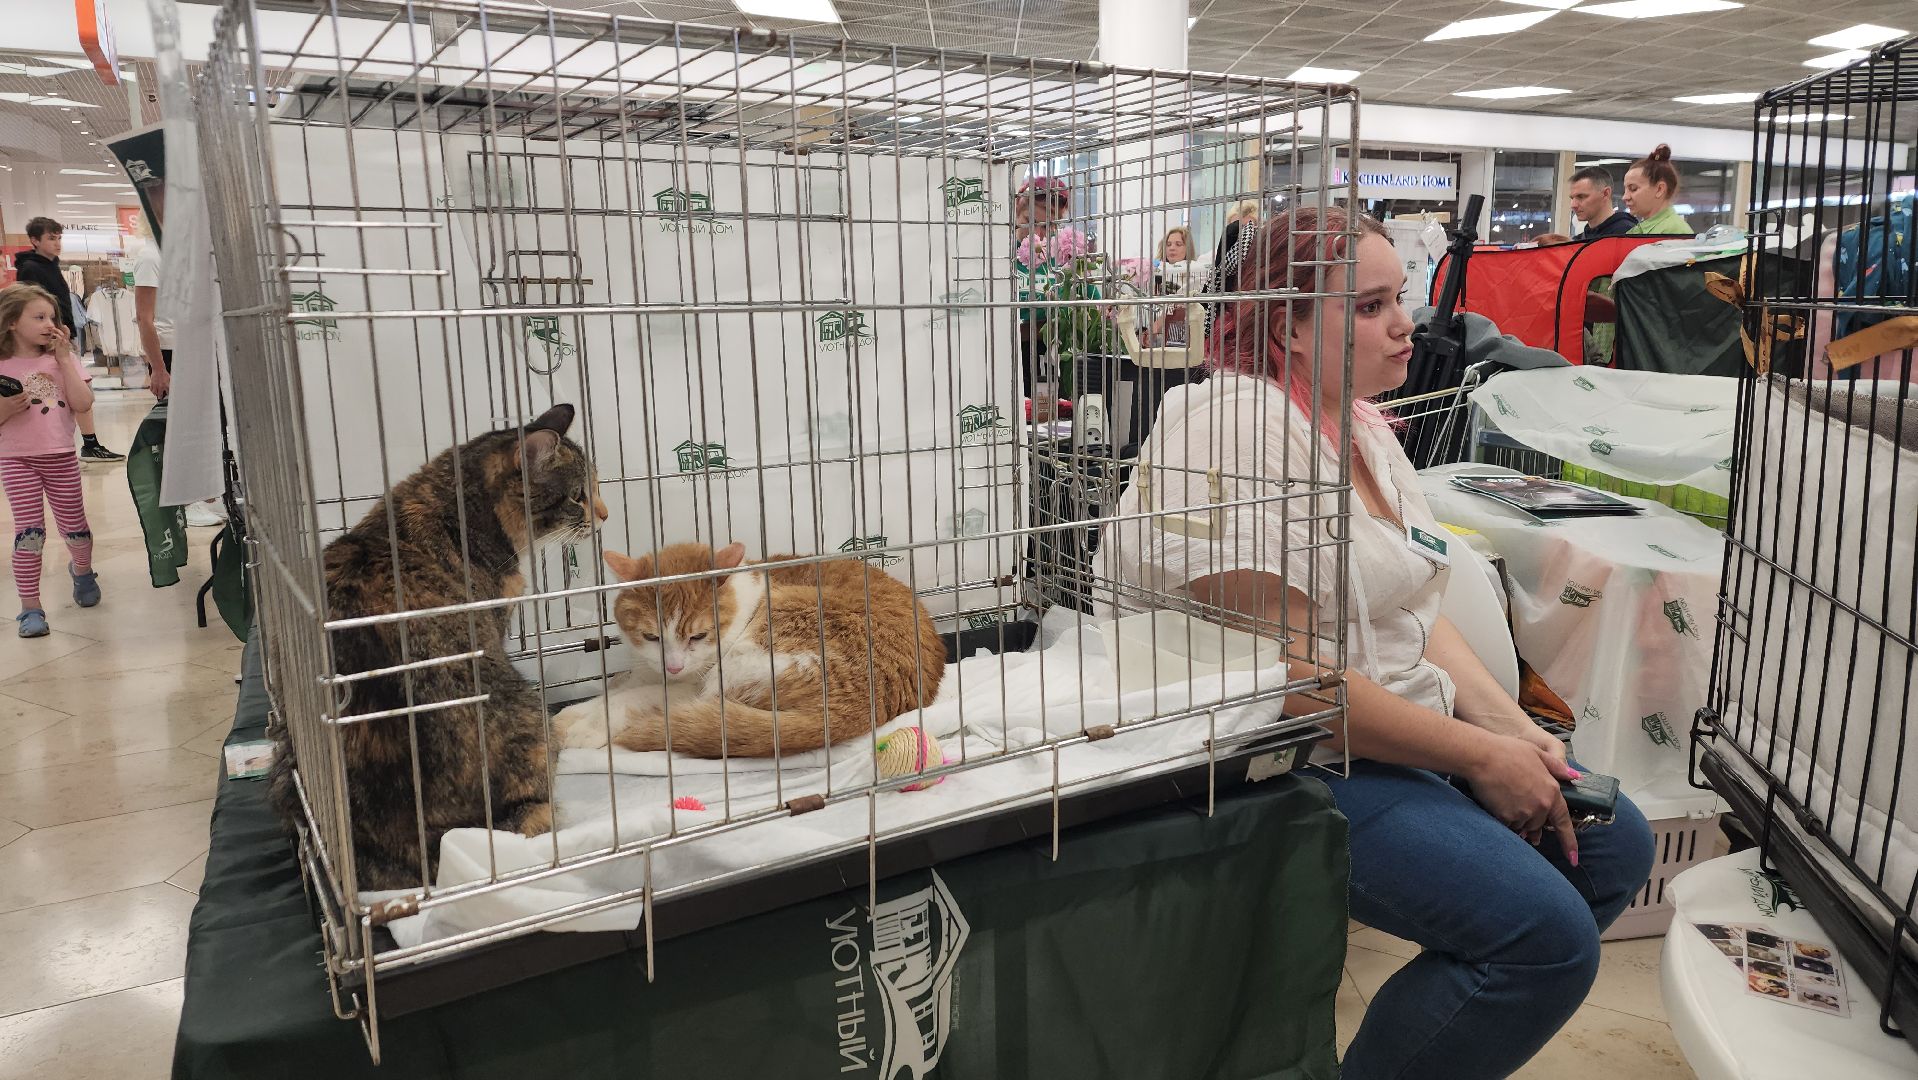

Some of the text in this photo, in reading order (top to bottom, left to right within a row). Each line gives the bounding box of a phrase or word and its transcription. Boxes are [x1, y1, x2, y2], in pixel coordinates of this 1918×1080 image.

[1342, 172, 1453, 188] KCHENLAND HOME
[818, 340, 857, 354] УЮТН
[825, 907, 876, 1073] УЮТНЫЙ
